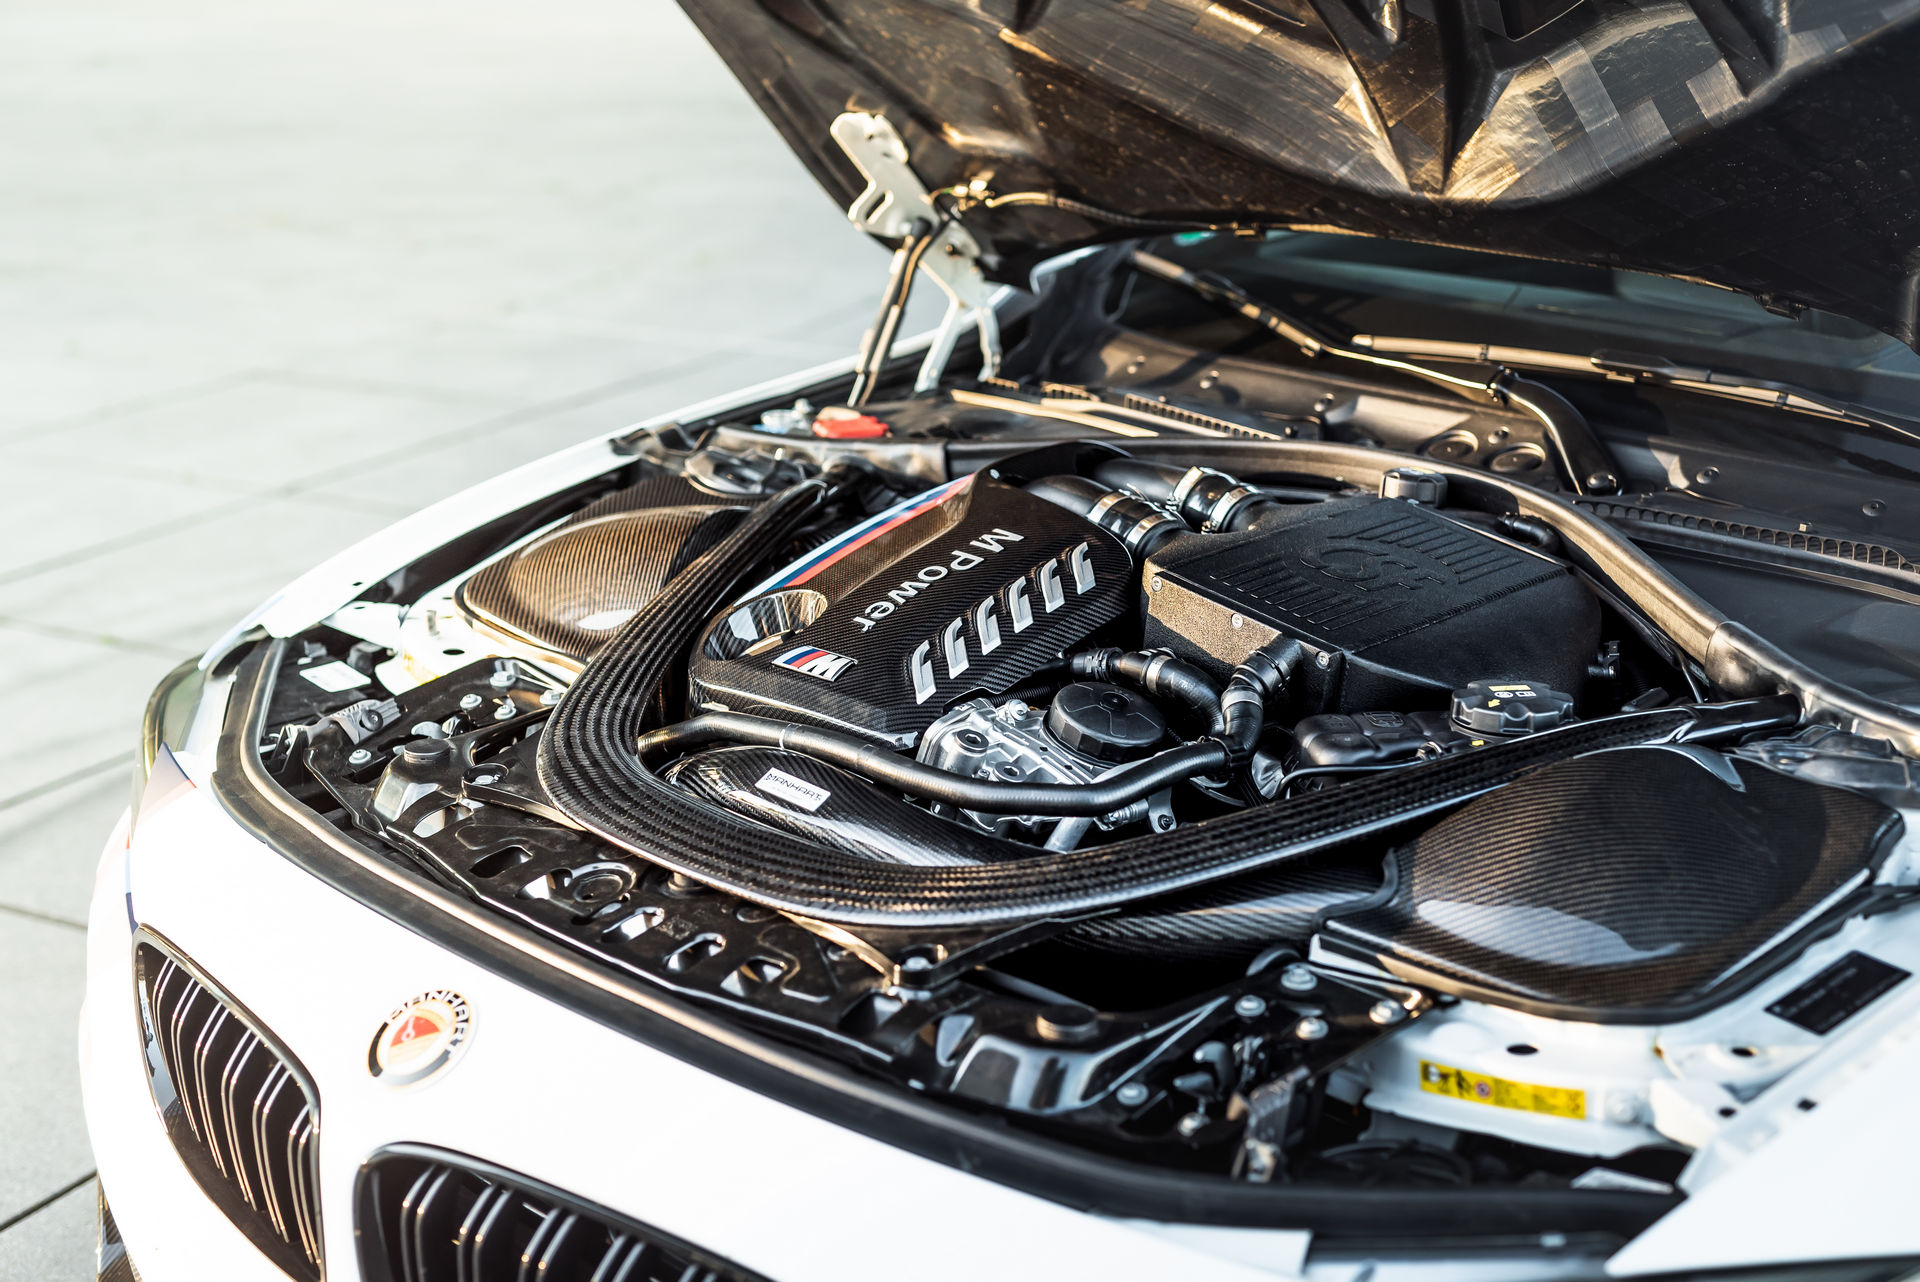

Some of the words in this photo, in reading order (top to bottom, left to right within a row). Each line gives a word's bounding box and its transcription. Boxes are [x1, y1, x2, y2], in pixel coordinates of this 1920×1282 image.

[970, 528, 1024, 552] M
[852, 550, 984, 632] Power
[764, 773, 823, 801] MANHART
